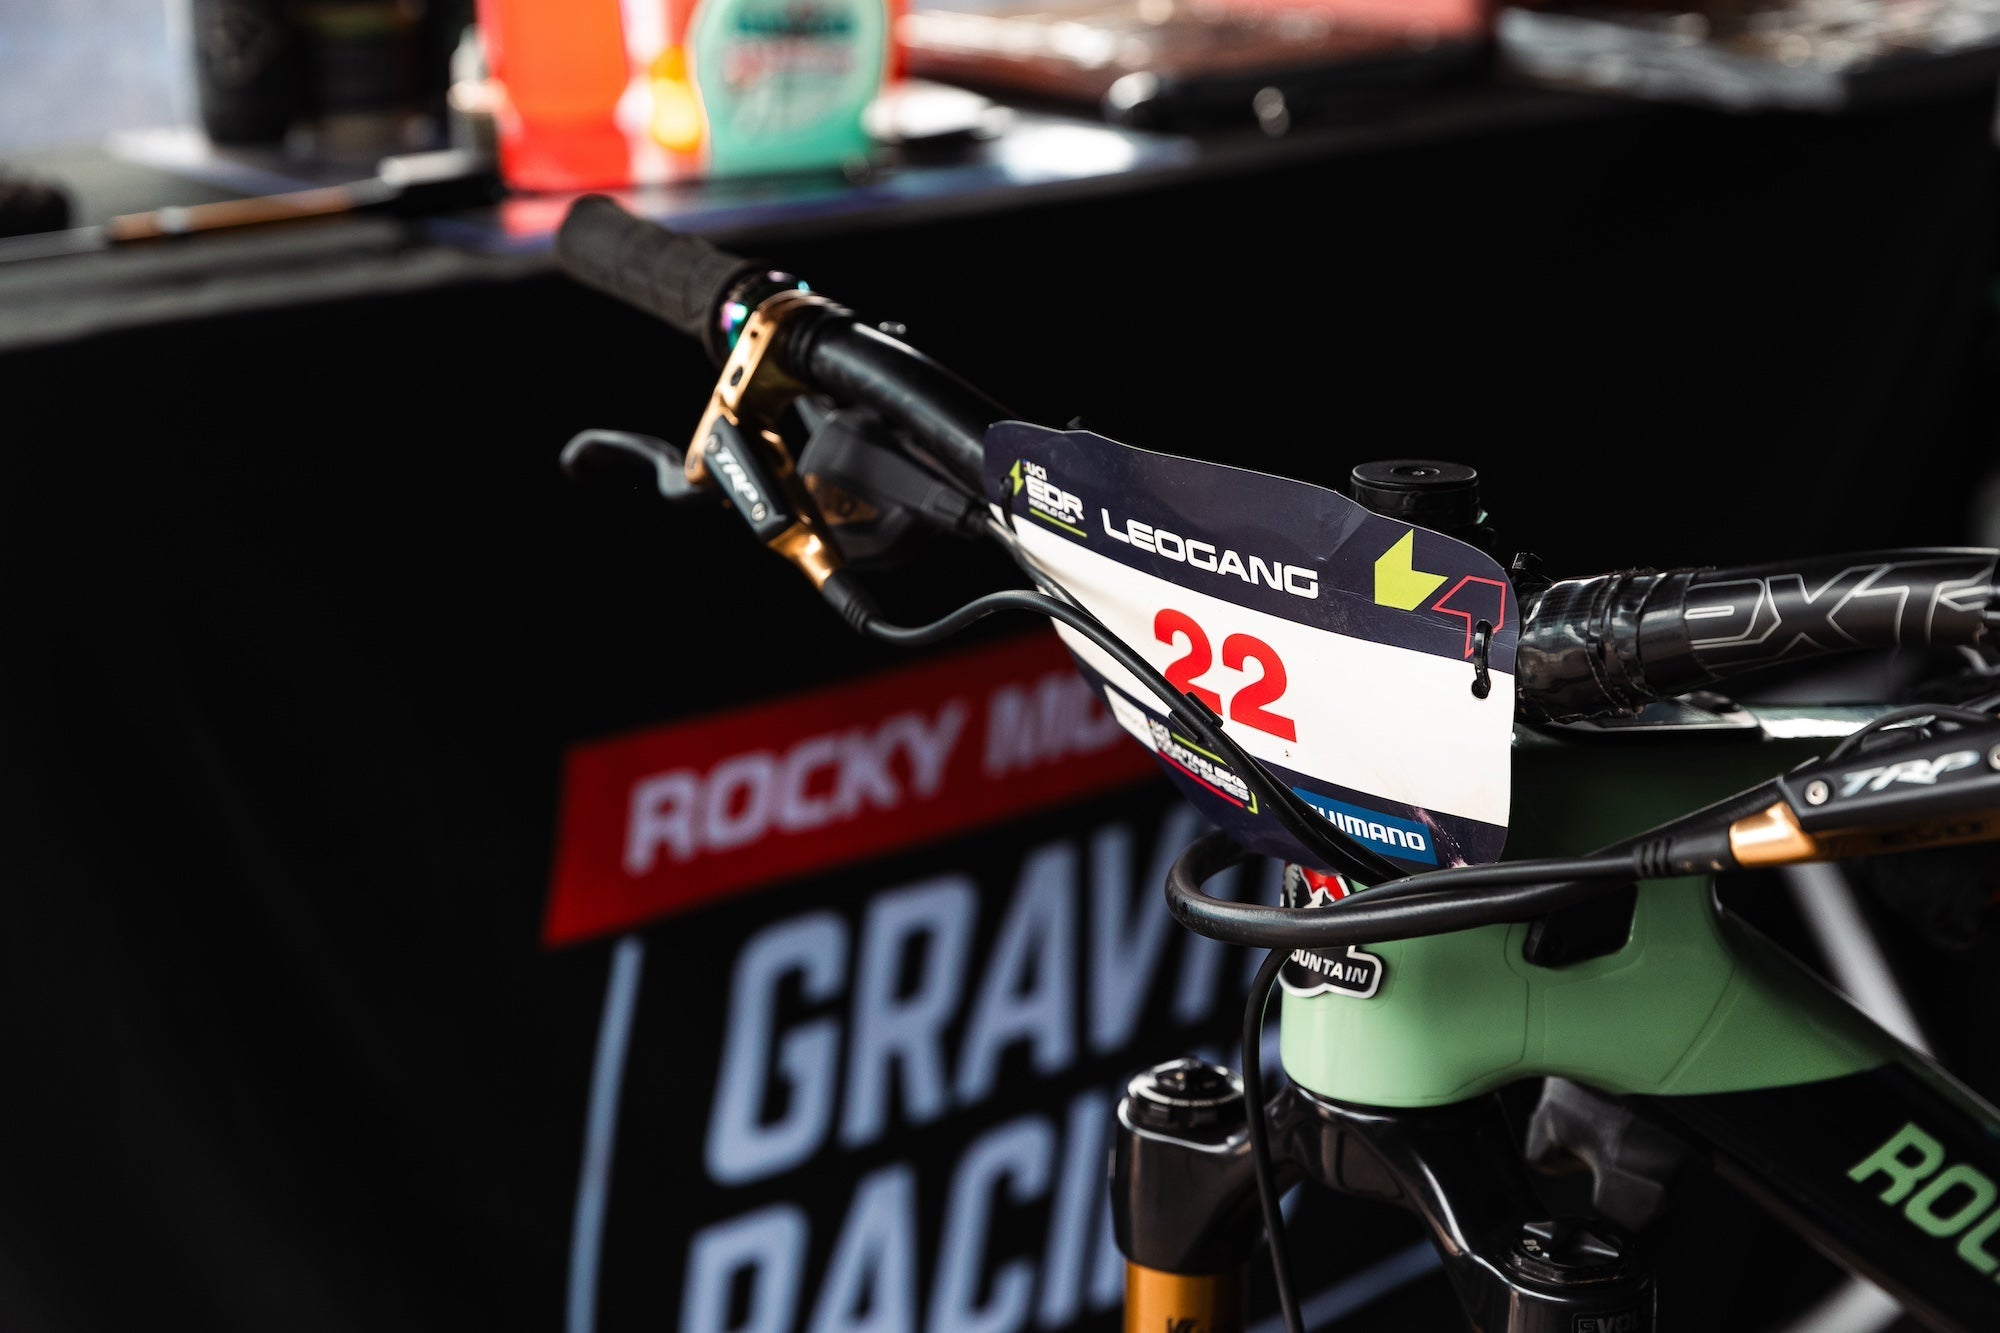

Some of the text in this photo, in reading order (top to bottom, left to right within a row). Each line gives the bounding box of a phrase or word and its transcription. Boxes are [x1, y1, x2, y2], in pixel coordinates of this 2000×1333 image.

[715, 446, 760, 502] TRP
[1026, 461, 1047, 481] UCI
[1025, 475, 1084, 520] EDR
[1101, 507, 1318, 599] LEOGANG
[1153, 608, 1297, 743] 22
[622, 700, 970, 877] ROCKY
[1840, 750, 1981, 797] TRP
[1289, 948, 1369, 984] OUNTAIN
